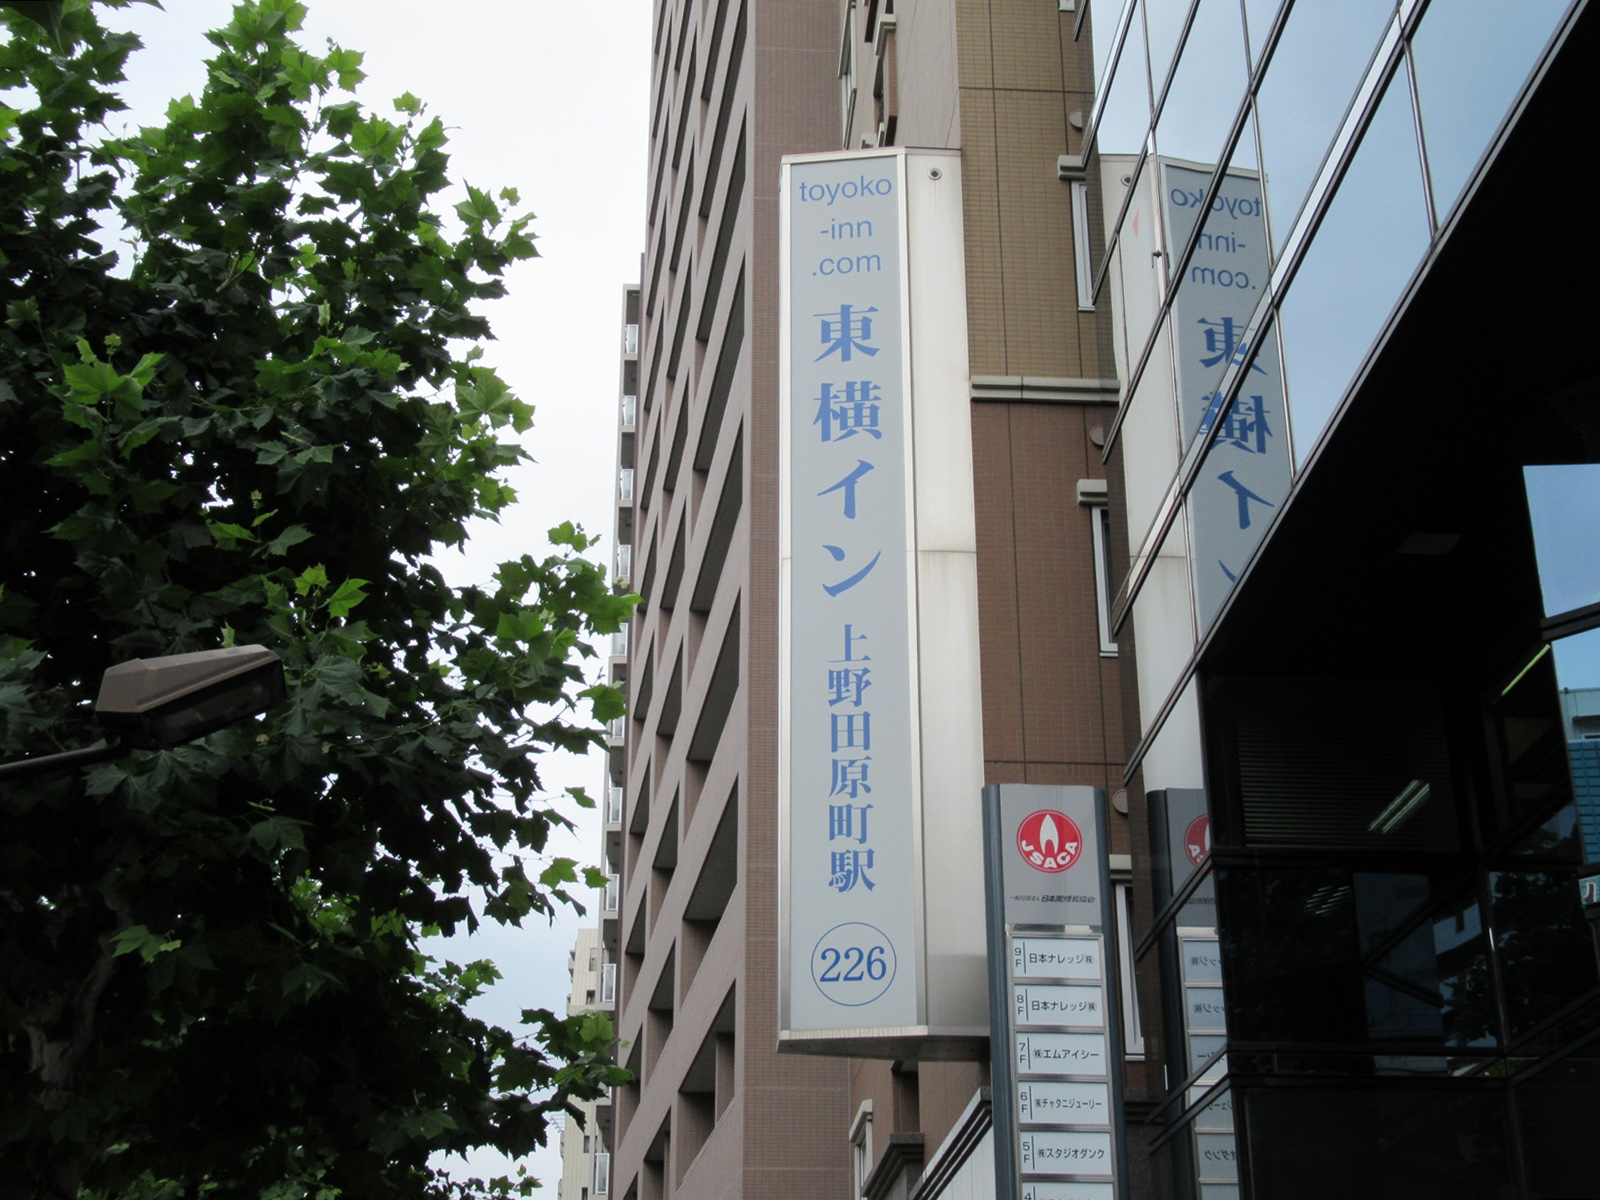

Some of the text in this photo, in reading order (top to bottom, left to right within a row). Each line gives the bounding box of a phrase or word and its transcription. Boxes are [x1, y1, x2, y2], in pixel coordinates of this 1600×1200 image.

[799, 175, 893, 207] toyoko
[820, 218, 873, 240] -inn
[812, 253, 882, 277] .com
[812, 303, 883, 598] 東横イン
[827, 623, 877, 893] 上野田原町駅
[1021, 839, 1079, 869] JSACA
[819, 945, 888, 983] 226
